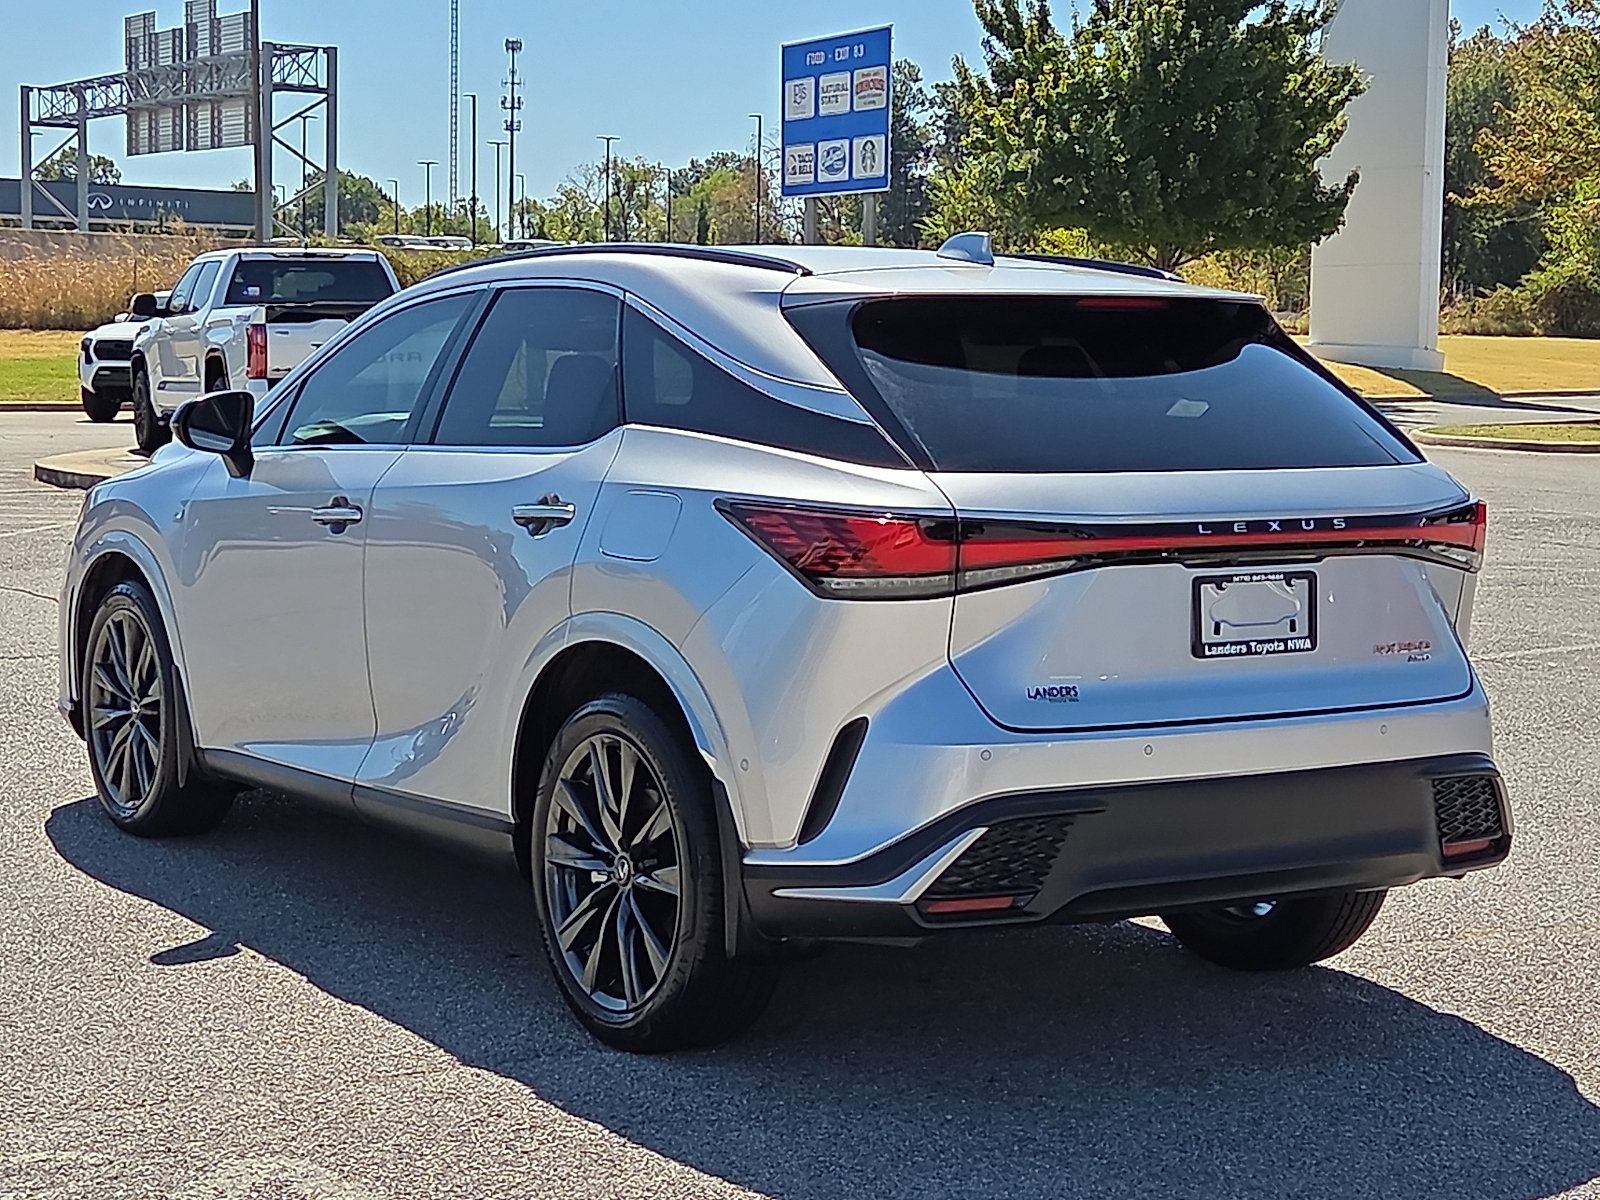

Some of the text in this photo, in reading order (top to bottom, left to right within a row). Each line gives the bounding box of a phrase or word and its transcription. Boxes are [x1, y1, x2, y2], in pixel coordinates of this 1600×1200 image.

[797, 152, 814, 163] TACO
[798, 164, 813, 175] BELL
[119, 198, 188, 208] INFINITI
[1198, 518, 1346, 534] LEXUS
[1205, 638, 1312, 656] Landers Toyota NWA
[1026, 685, 1078, 699] LANDERS
